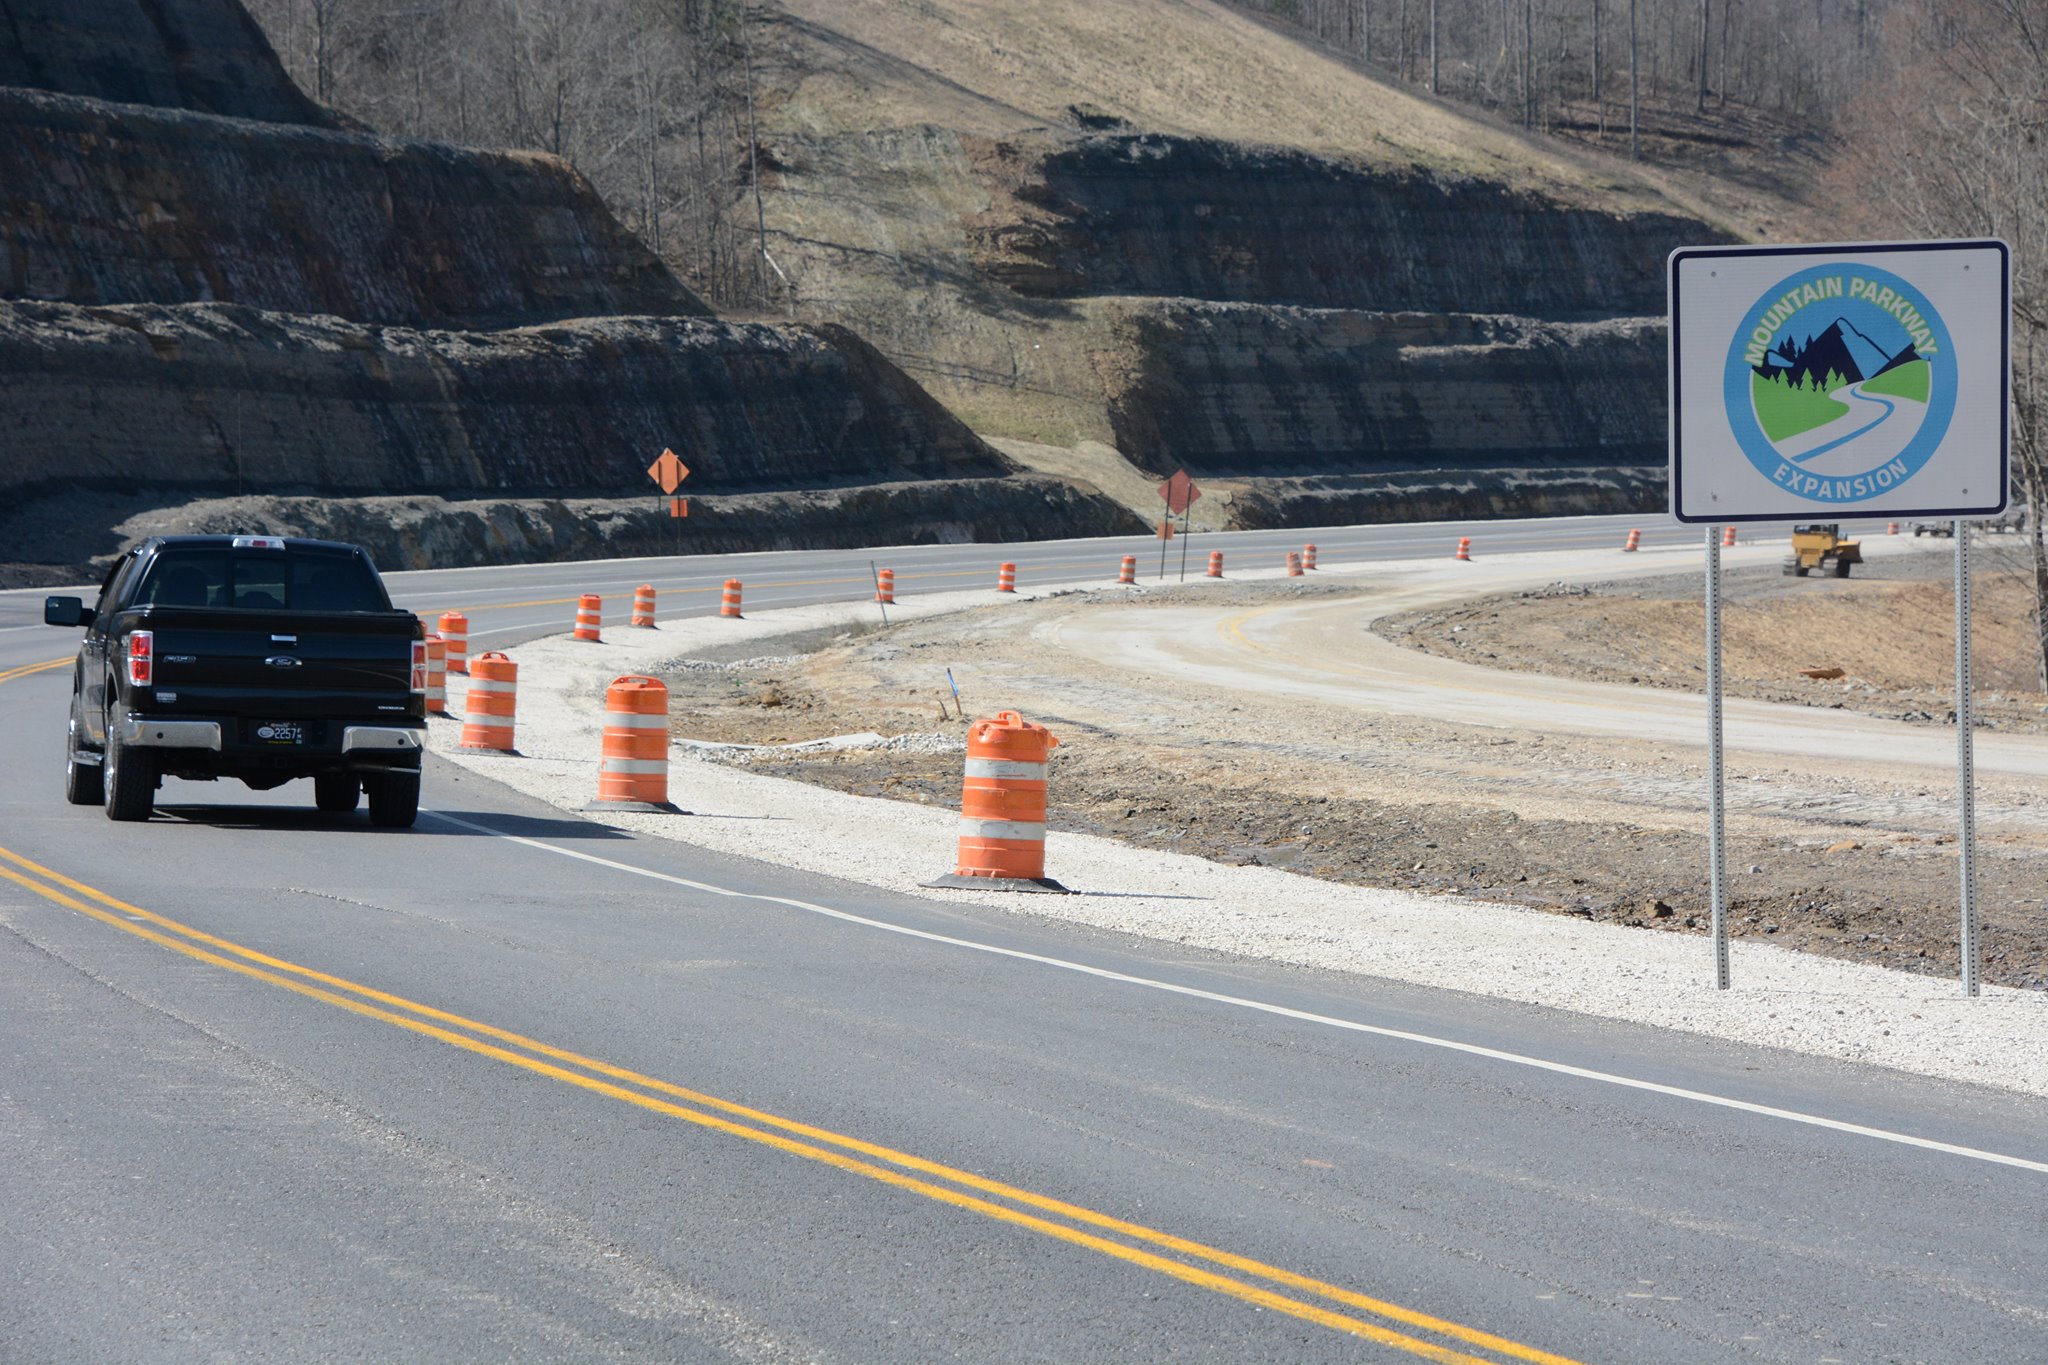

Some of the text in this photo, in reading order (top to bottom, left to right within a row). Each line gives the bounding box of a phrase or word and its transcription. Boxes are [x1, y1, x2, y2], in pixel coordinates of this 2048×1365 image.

[1743, 276, 1939, 368] MOUNTAIN PARKWAY
[1772, 458, 1909, 499] EXPANSION
